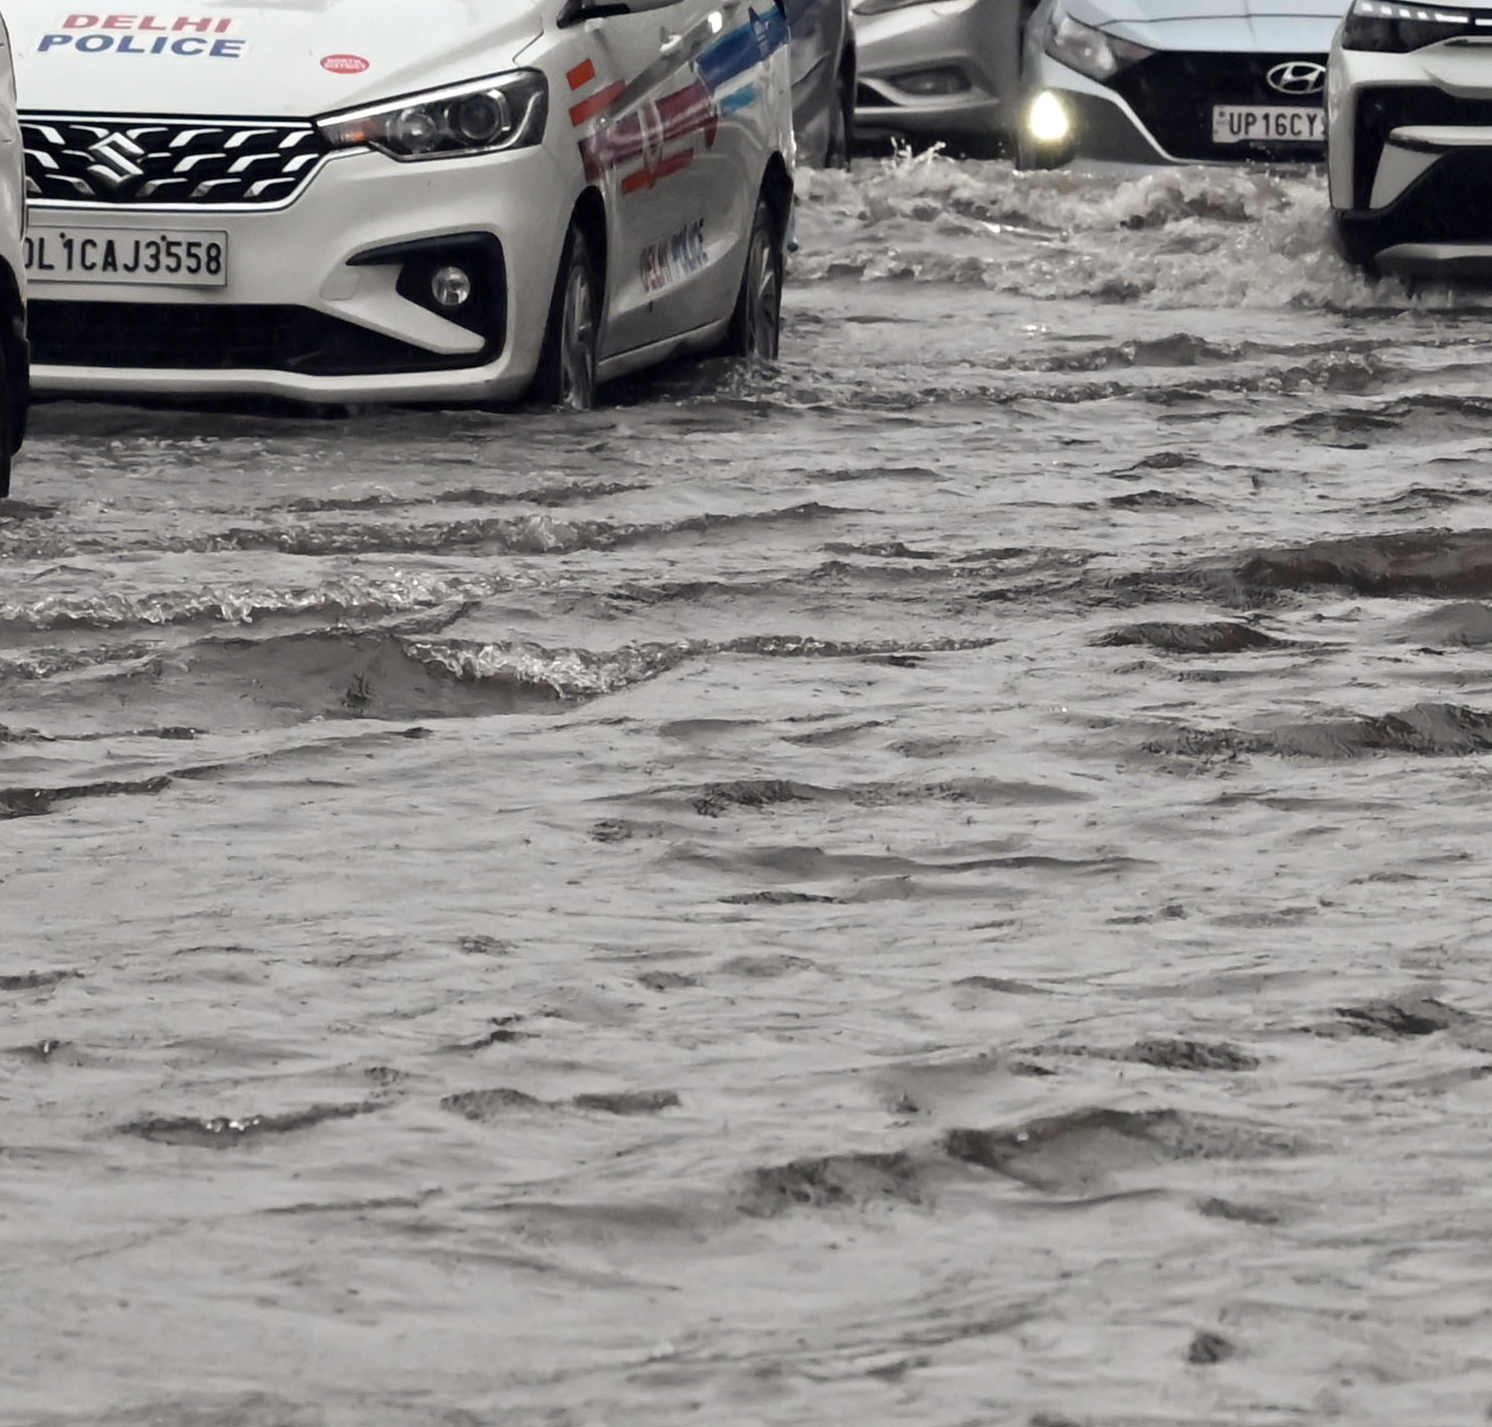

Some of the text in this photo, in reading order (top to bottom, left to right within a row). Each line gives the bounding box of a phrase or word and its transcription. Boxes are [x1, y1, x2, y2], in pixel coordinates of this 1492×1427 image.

[63, 13, 232, 34] DELHI
[37, 34, 246, 59] POLICE
[1229, 112, 1324, 137] UP16CY
